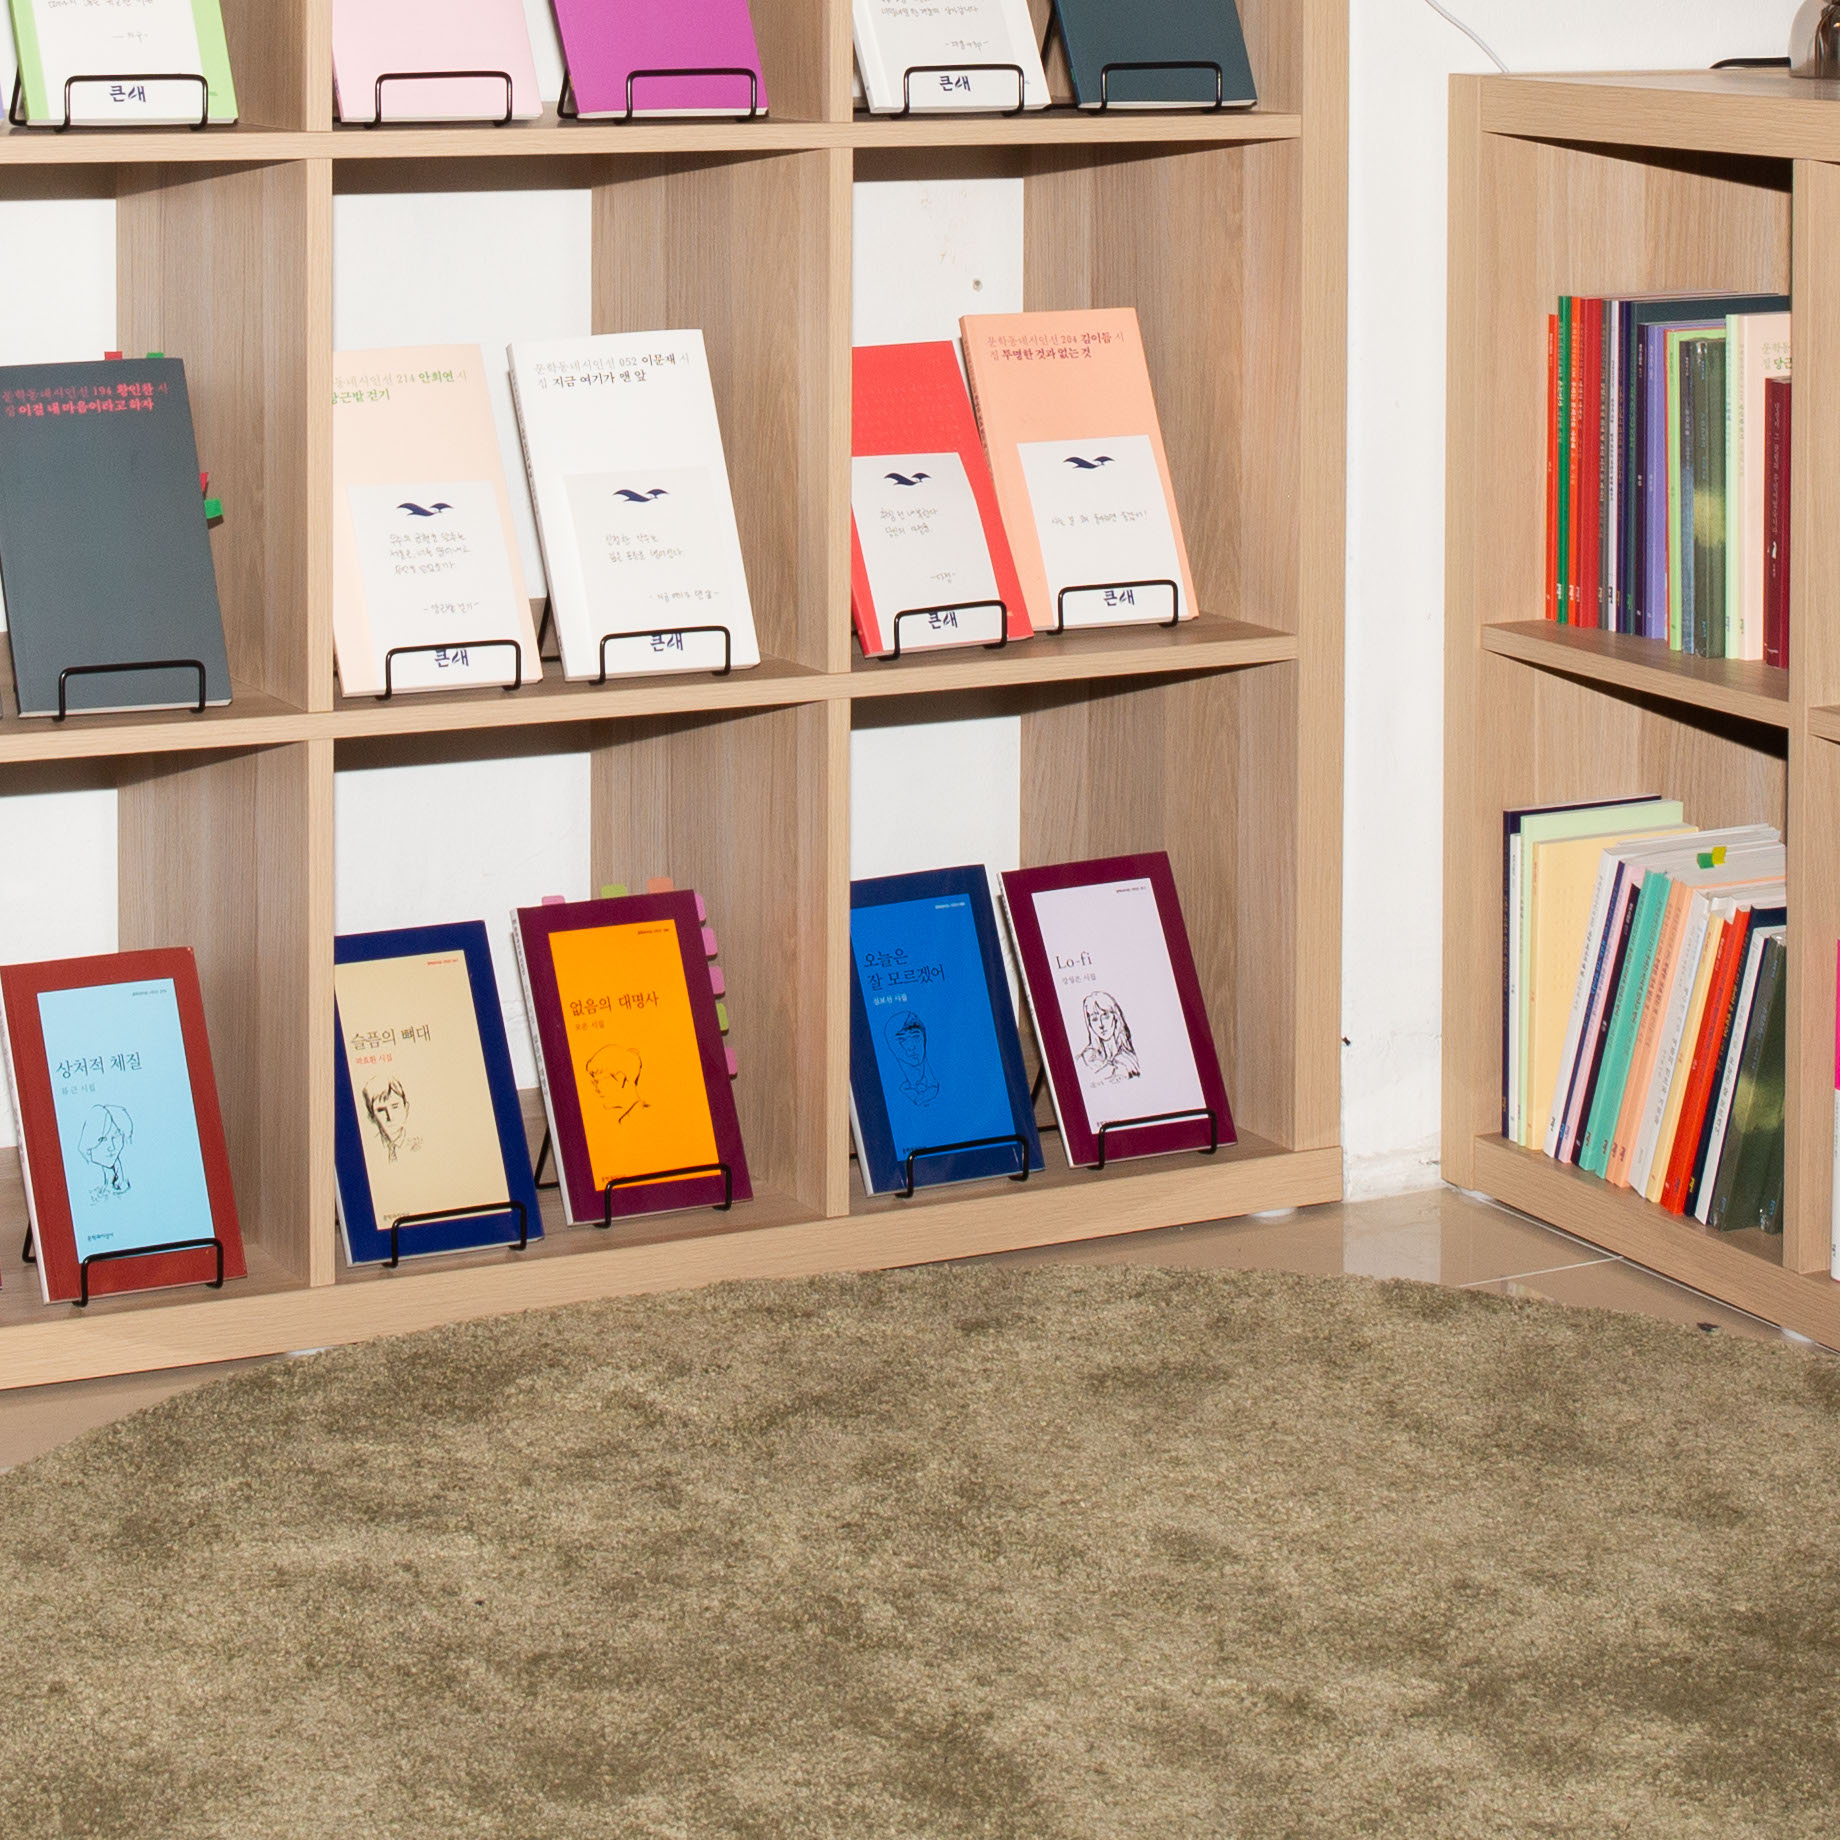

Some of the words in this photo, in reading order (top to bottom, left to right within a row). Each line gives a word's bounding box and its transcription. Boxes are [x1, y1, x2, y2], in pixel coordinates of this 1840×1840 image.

[940, 76, 971, 91] 큰새
[109, 85, 147, 103] 큰새
[642, 353, 676, 367] 이문재
[553, 376, 576, 388] 지금
[580, 372, 615, 386] 여기가
[634, 369, 647, 382] 앞
[1104, 589, 1134, 607] 큰새
[864, 947, 908, 969] 오늘은
[1055, 951, 1093, 970] Lo-fi
[866, 971, 883, 991] 잘
[887, 963, 945, 987] 모르겠어
[569, 996, 612, 1017] 없음의
[618, 991, 659, 1011] 대명사
[350, 1027, 397, 1052] 슬픔의
[401, 1023, 432, 1044] 뼈대
[55, 1056, 105, 1080] 상처적
[109, 1052, 143, 1074] 체질
